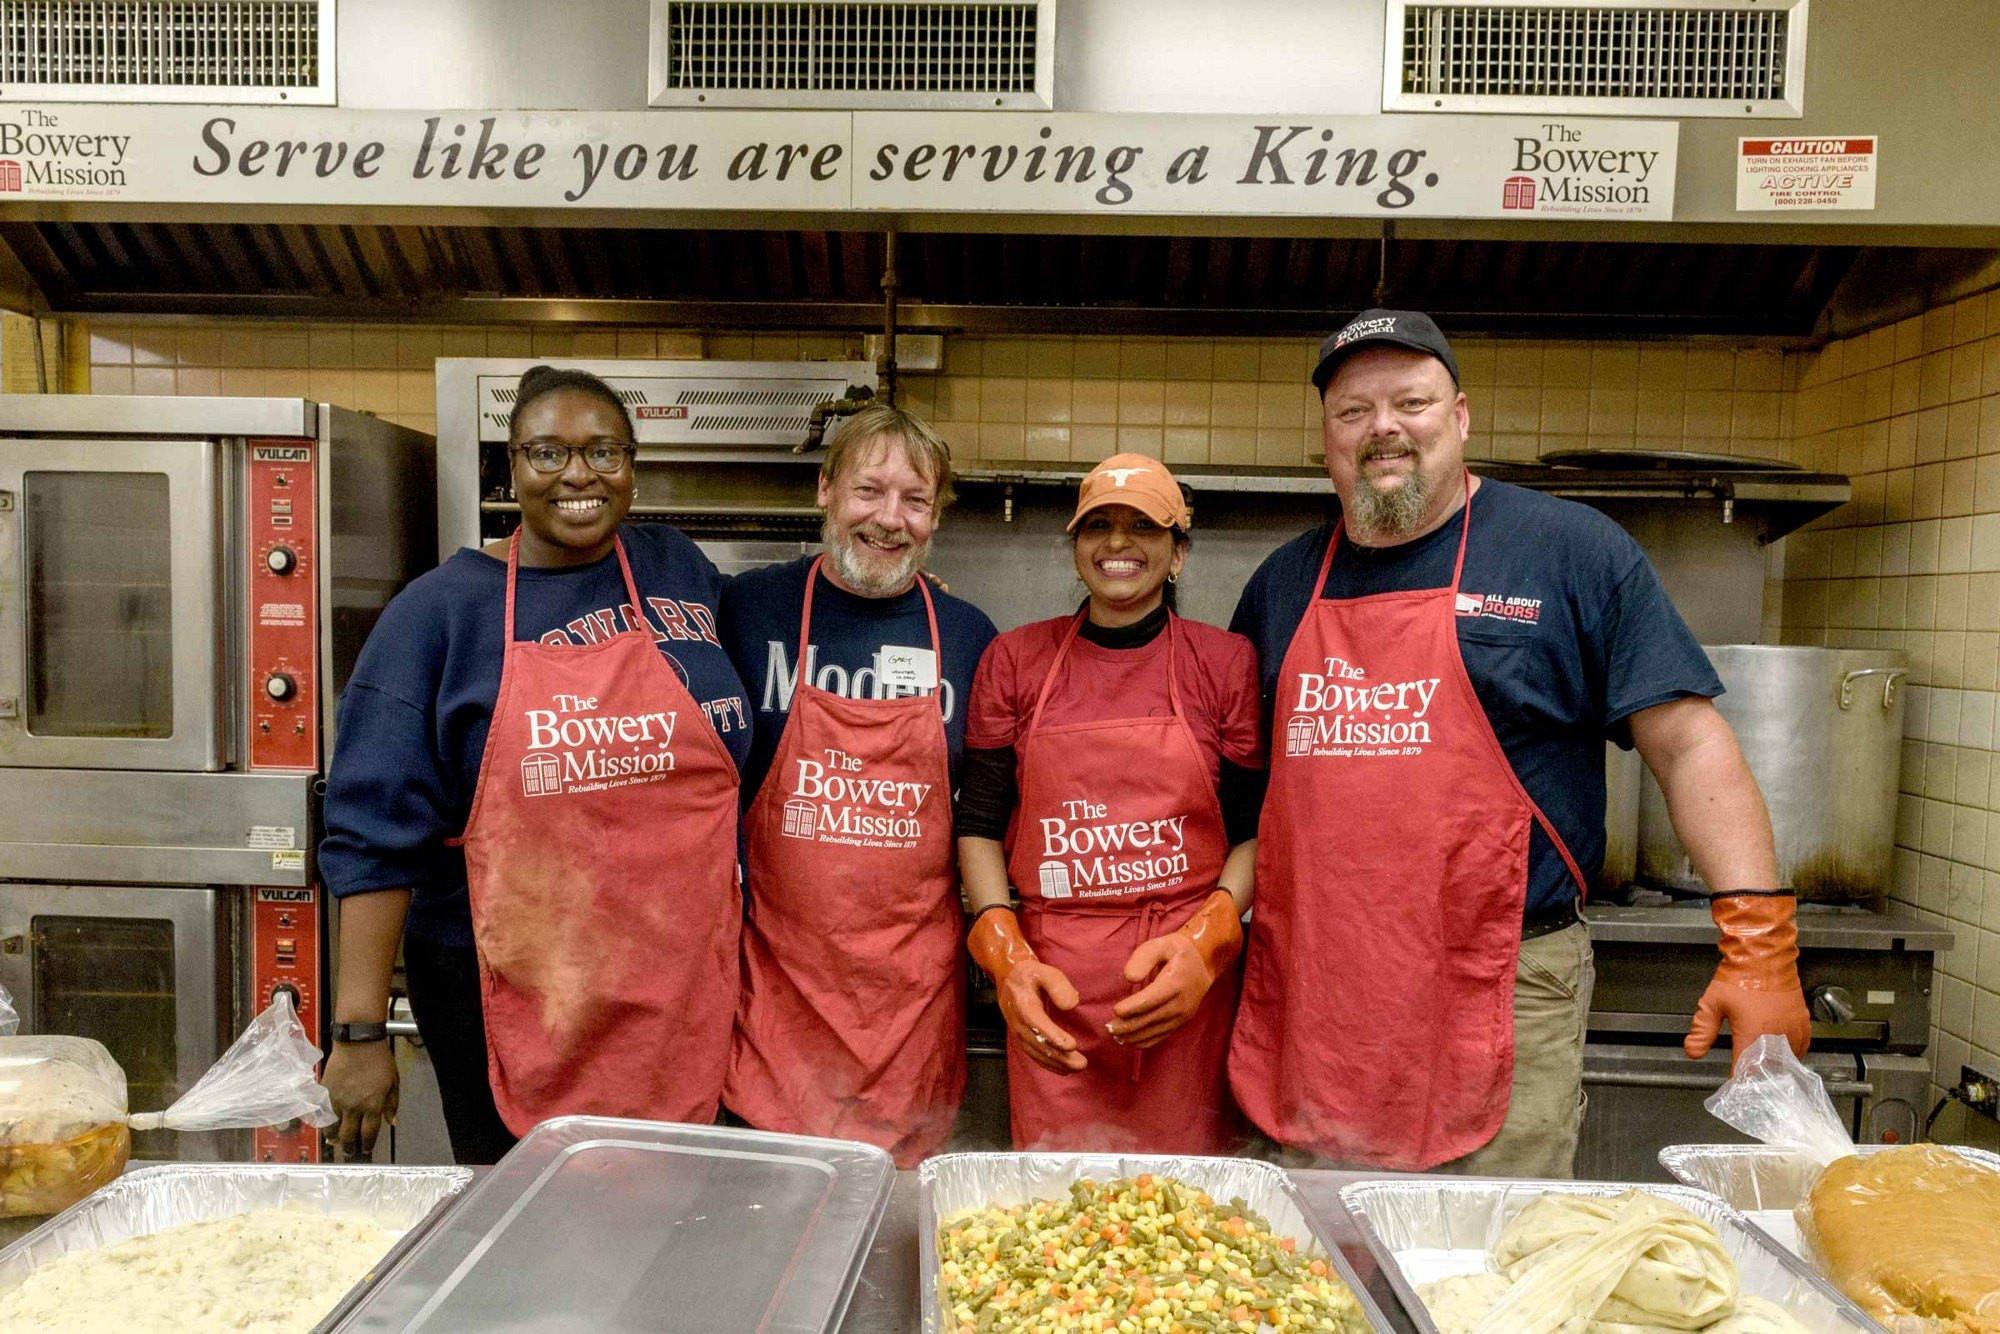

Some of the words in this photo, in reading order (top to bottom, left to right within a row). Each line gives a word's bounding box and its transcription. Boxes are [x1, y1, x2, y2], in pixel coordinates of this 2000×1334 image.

[21, 109, 58, 127] The
[1542, 124, 1582, 142] The
[0, 123, 131, 166] Bowery
[1770, 141, 1847, 154] CAUTION
[193, 117, 386, 178] Serve
[412, 116, 546, 180] like
[564, 142, 699, 202] you
[727, 142, 843, 181] are
[869, 126, 1144, 206] serving
[1165, 145, 1210, 185] a
[1236, 125, 1439, 209] King.
[1511, 137, 1659, 183] Bowery
[1746, 166, 1781, 174] LIGHTING
[1783, 165, 1819, 173] COOKING
[1821, 165, 1869, 173] APPLIANCES
[1747, 157, 1767, 165] TURN
[1769, 157, 1780, 165] ON
[1782, 156, 1818, 164] EXHAUST
[1820, 156, 1835, 164] FAN
[25, 160, 127, 186] Mission
[1760, 174, 1854, 189] ACTIVE
[1538, 176, 1650, 204] Mission
[1774, 198, 1796, 207] (800)
[1346, 325, 1395, 344] Mission
[641, 407, 682, 418] VULCAN
[256, 448, 308, 461] VULCAN
[1483, 602, 1534, 619] DOORS
[1485, 593, 1504, 604] ALL
[1505, 596, 1542, 608] ABOUT
[1324, 657, 1365, 681] The
[553, 694, 598, 713] The
[1293, 673, 1441, 719] Bowery
[524, 710, 678, 750] Bowery
[1312, 713, 1432, 745] Mission
[824, 748, 863, 772] The
[1312, 747, 1353, 758] Rebuilding
[1353, 747, 1376, 757] Lives
[1377, 747, 1400, 757] Since
[1401, 746, 1422, 756] 1879
[562, 746, 676, 782] Mission
[568, 781, 609, 794] Rebuilding
[609, 779, 628, 788] Lives
[628, 776, 649, 785] Since
[650, 774, 667, 783] 1879
[792, 759, 932, 816] Bowery
[1062, 799, 1108, 821] The
[816, 804, 922, 838] Mission
[818, 834, 862, 847] Rebuilding
[863, 838, 882, 848] Lives
[883, 839, 903, 849] Since
[903, 840, 918, 849] 1879
[1039, 815, 1189, 857] Bowery
[1071, 850, 1190, 888] Mission
[261, 888, 311, 902] VULCAN
[1079, 888, 1123, 899] Rebuilding
[1124, 885, 1145, 895] Lives
[1146, 882, 1167, 892] Since
[1167, 876, 1184, 888] 1879
